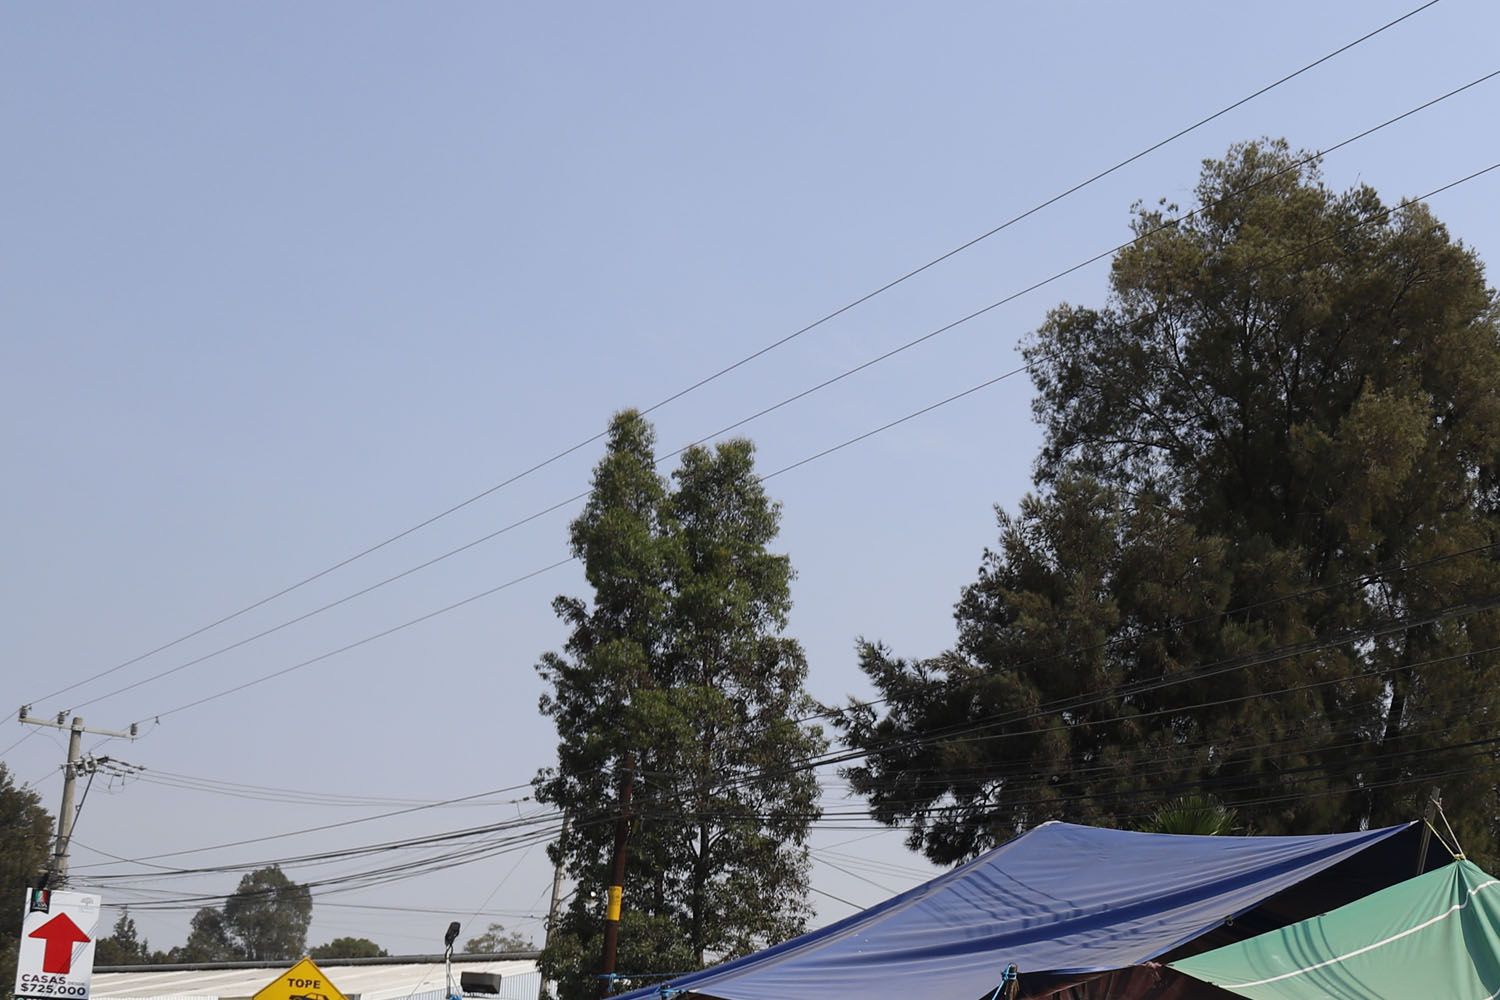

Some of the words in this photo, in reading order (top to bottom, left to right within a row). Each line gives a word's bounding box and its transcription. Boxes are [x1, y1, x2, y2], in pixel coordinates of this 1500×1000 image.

[21, 974, 66, 985] CASAS
[287, 978, 321, 990] TOPE
[20, 983, 86, 996] $725,000
